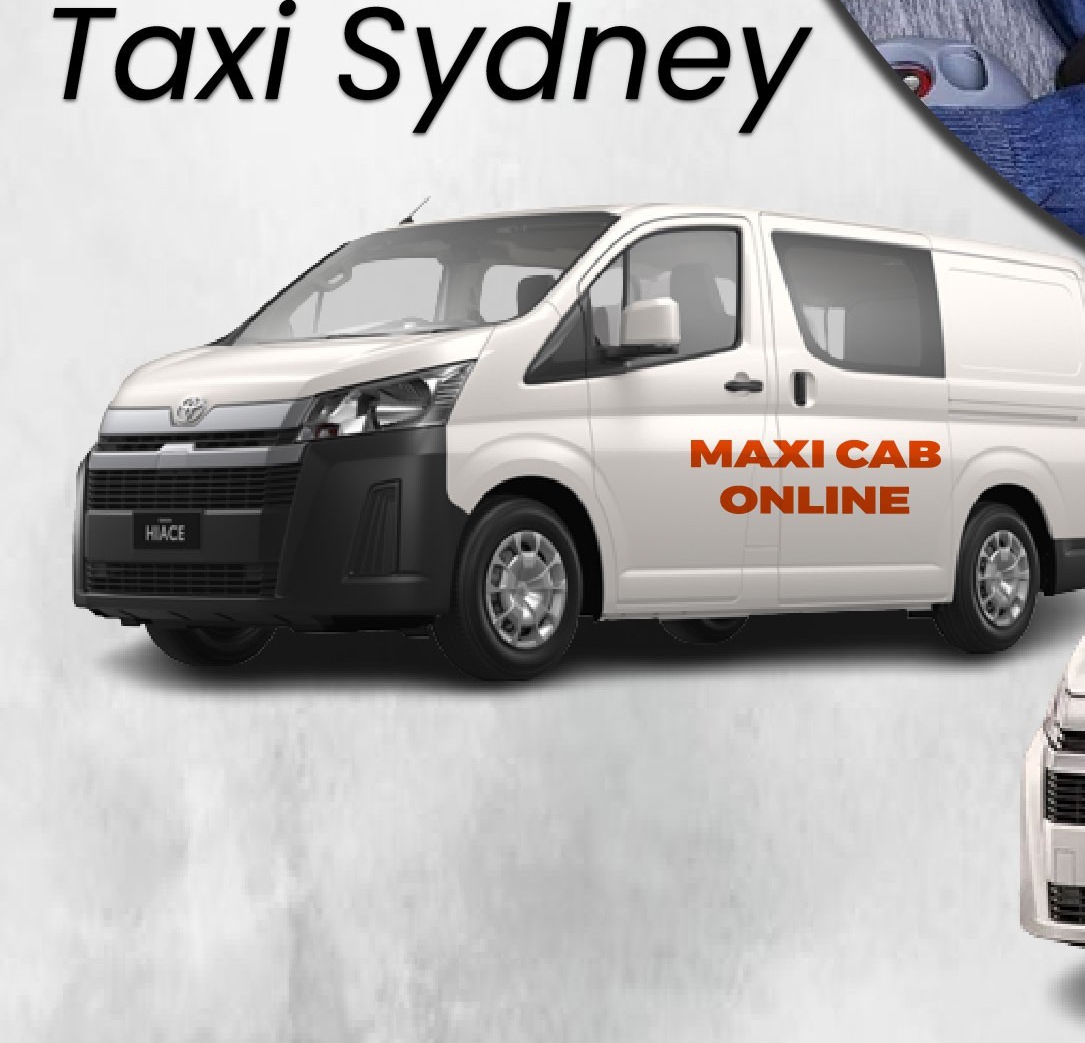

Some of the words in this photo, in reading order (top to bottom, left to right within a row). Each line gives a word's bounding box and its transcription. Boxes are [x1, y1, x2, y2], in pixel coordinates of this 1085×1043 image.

[690, 439, 825, 468] MAXI
[835, 439, 942, 469] CAB
[719, 485, 910, 514] ONLINE
[145, 524, 186, 541] HIACE
